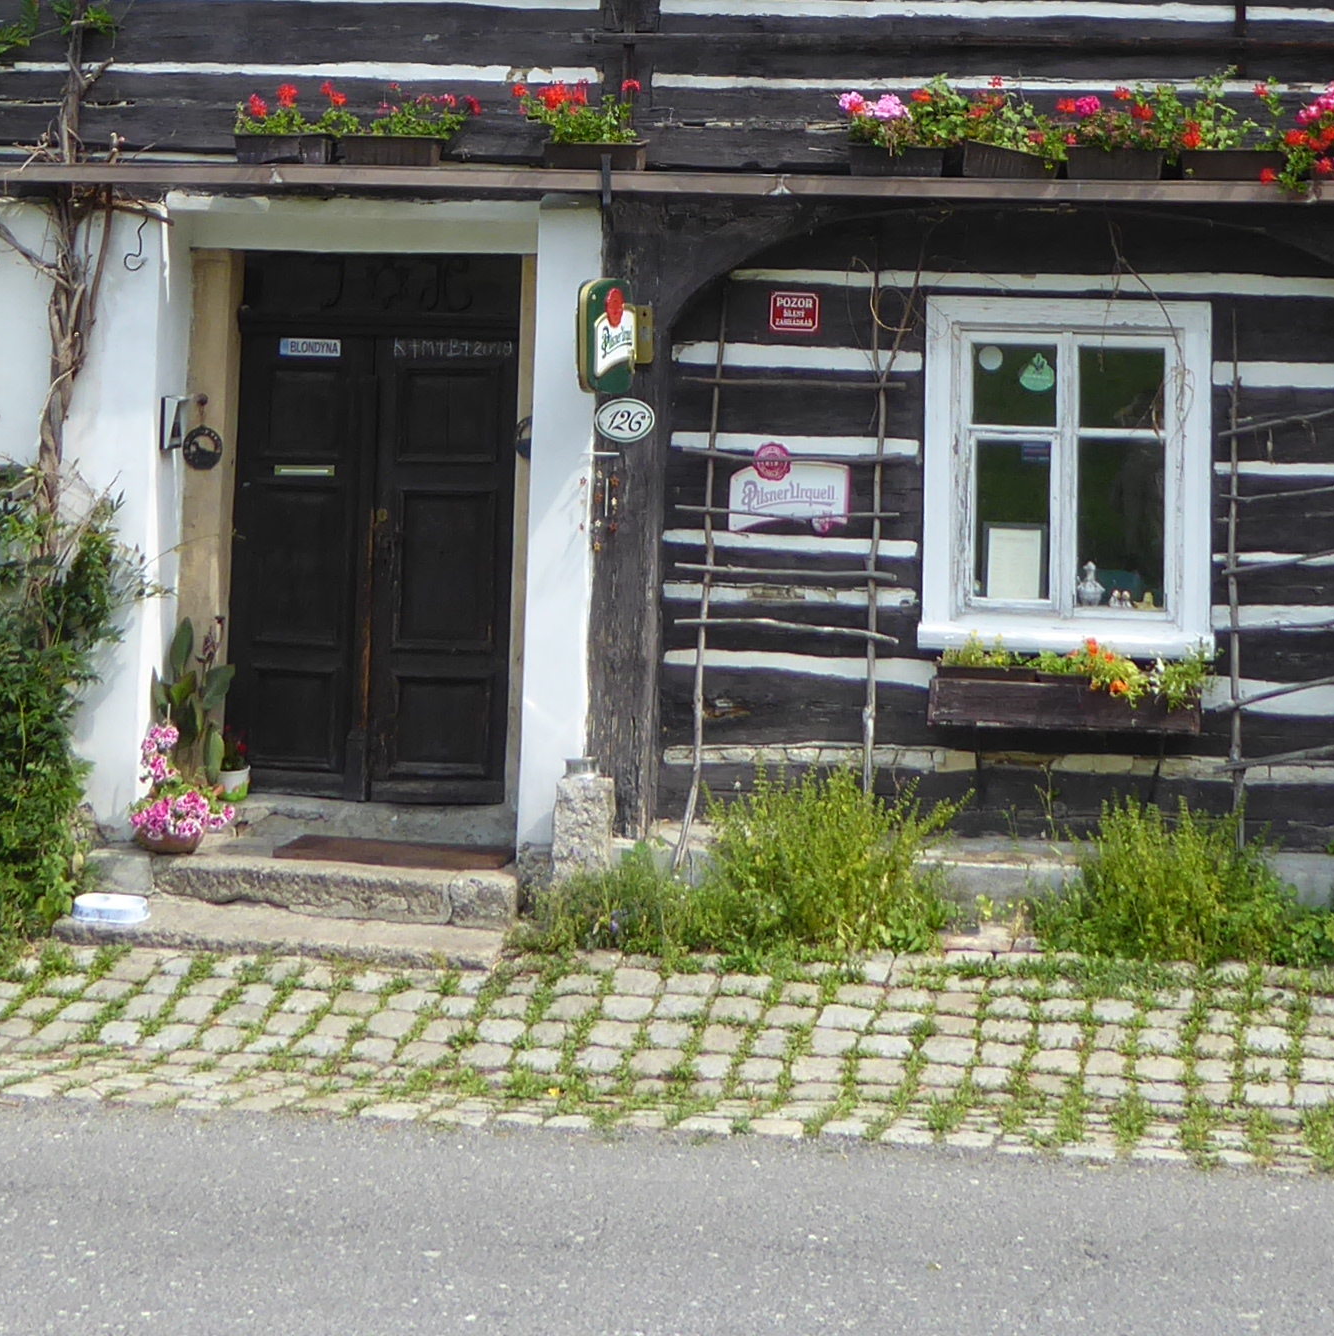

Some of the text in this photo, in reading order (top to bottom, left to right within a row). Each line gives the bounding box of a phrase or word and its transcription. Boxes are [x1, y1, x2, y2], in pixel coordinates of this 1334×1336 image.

[776, 297, 813, 308] POZOR
[607, 409, 646, 432] 126
[741, 480, 835, 512] Pilsner Urquell
